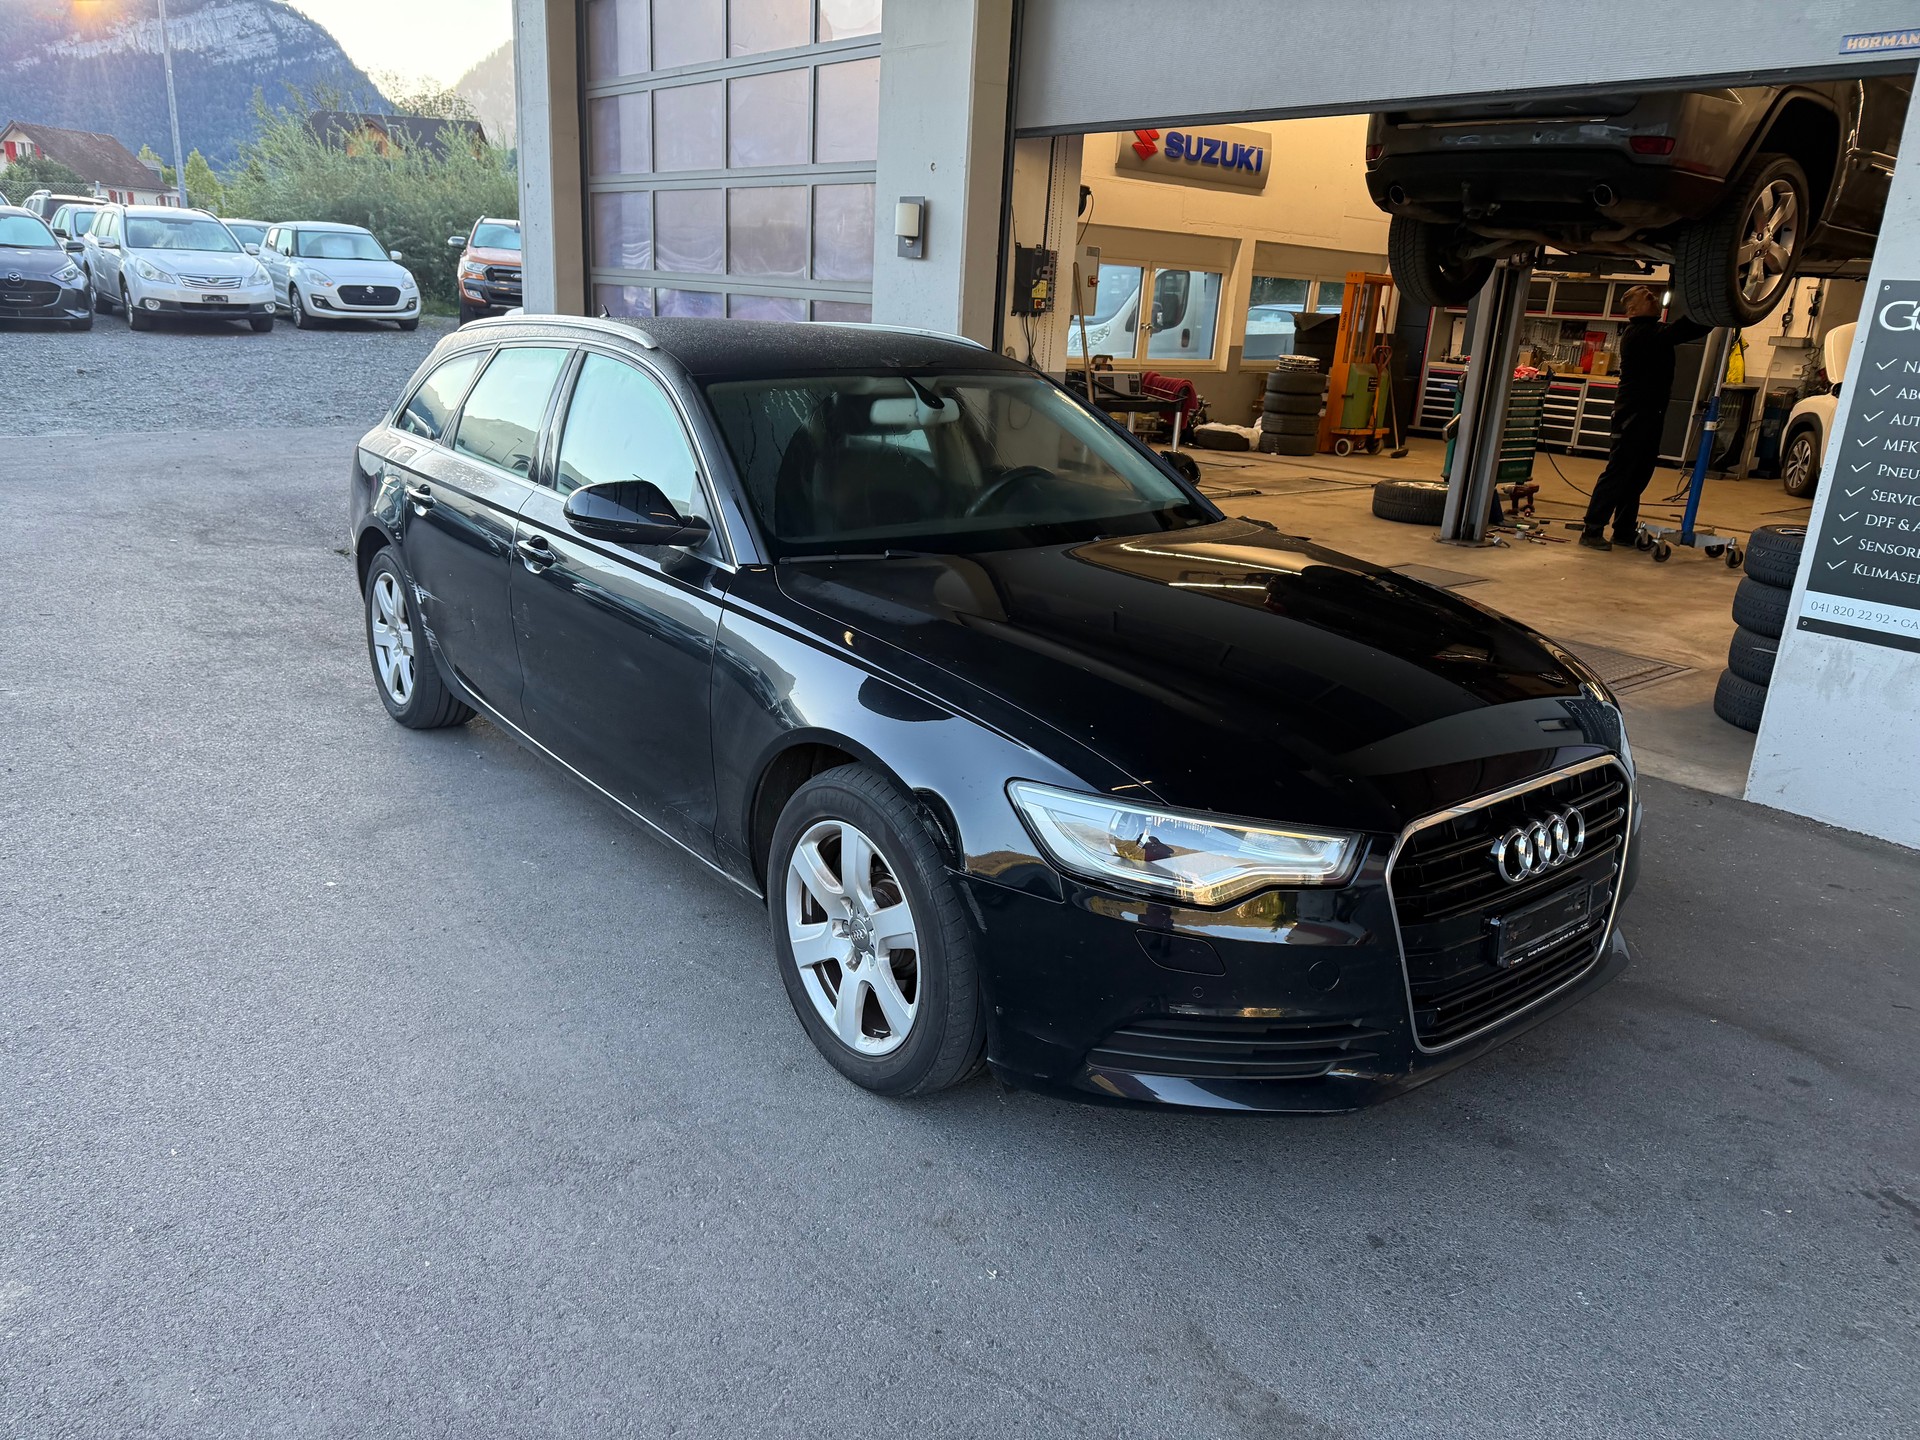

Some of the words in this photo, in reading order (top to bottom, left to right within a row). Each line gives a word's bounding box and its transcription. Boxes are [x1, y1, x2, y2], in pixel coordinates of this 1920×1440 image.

[1164, 131, 1263, 172] SUZUKI
[1879, 300, 1920, 331] G
[1896, 387, 1920, 400] AB
[1883, 438, 1920, 454] MFK
[1877, 463, 1920, 480] PNEU
[1865, 513, 1896, 529] DPF
[1898, 518, 1910, 532] &
[1852, 562, 1920, 585] KLIMASE
[1810, 601, 1830, 613] 041
[1832, 605, 1855, 618] 820
[1857, 609, 1872, 621] 22
[1875, 612, 1890, 624] 92
[1900, 618, 1920, 630] GA
